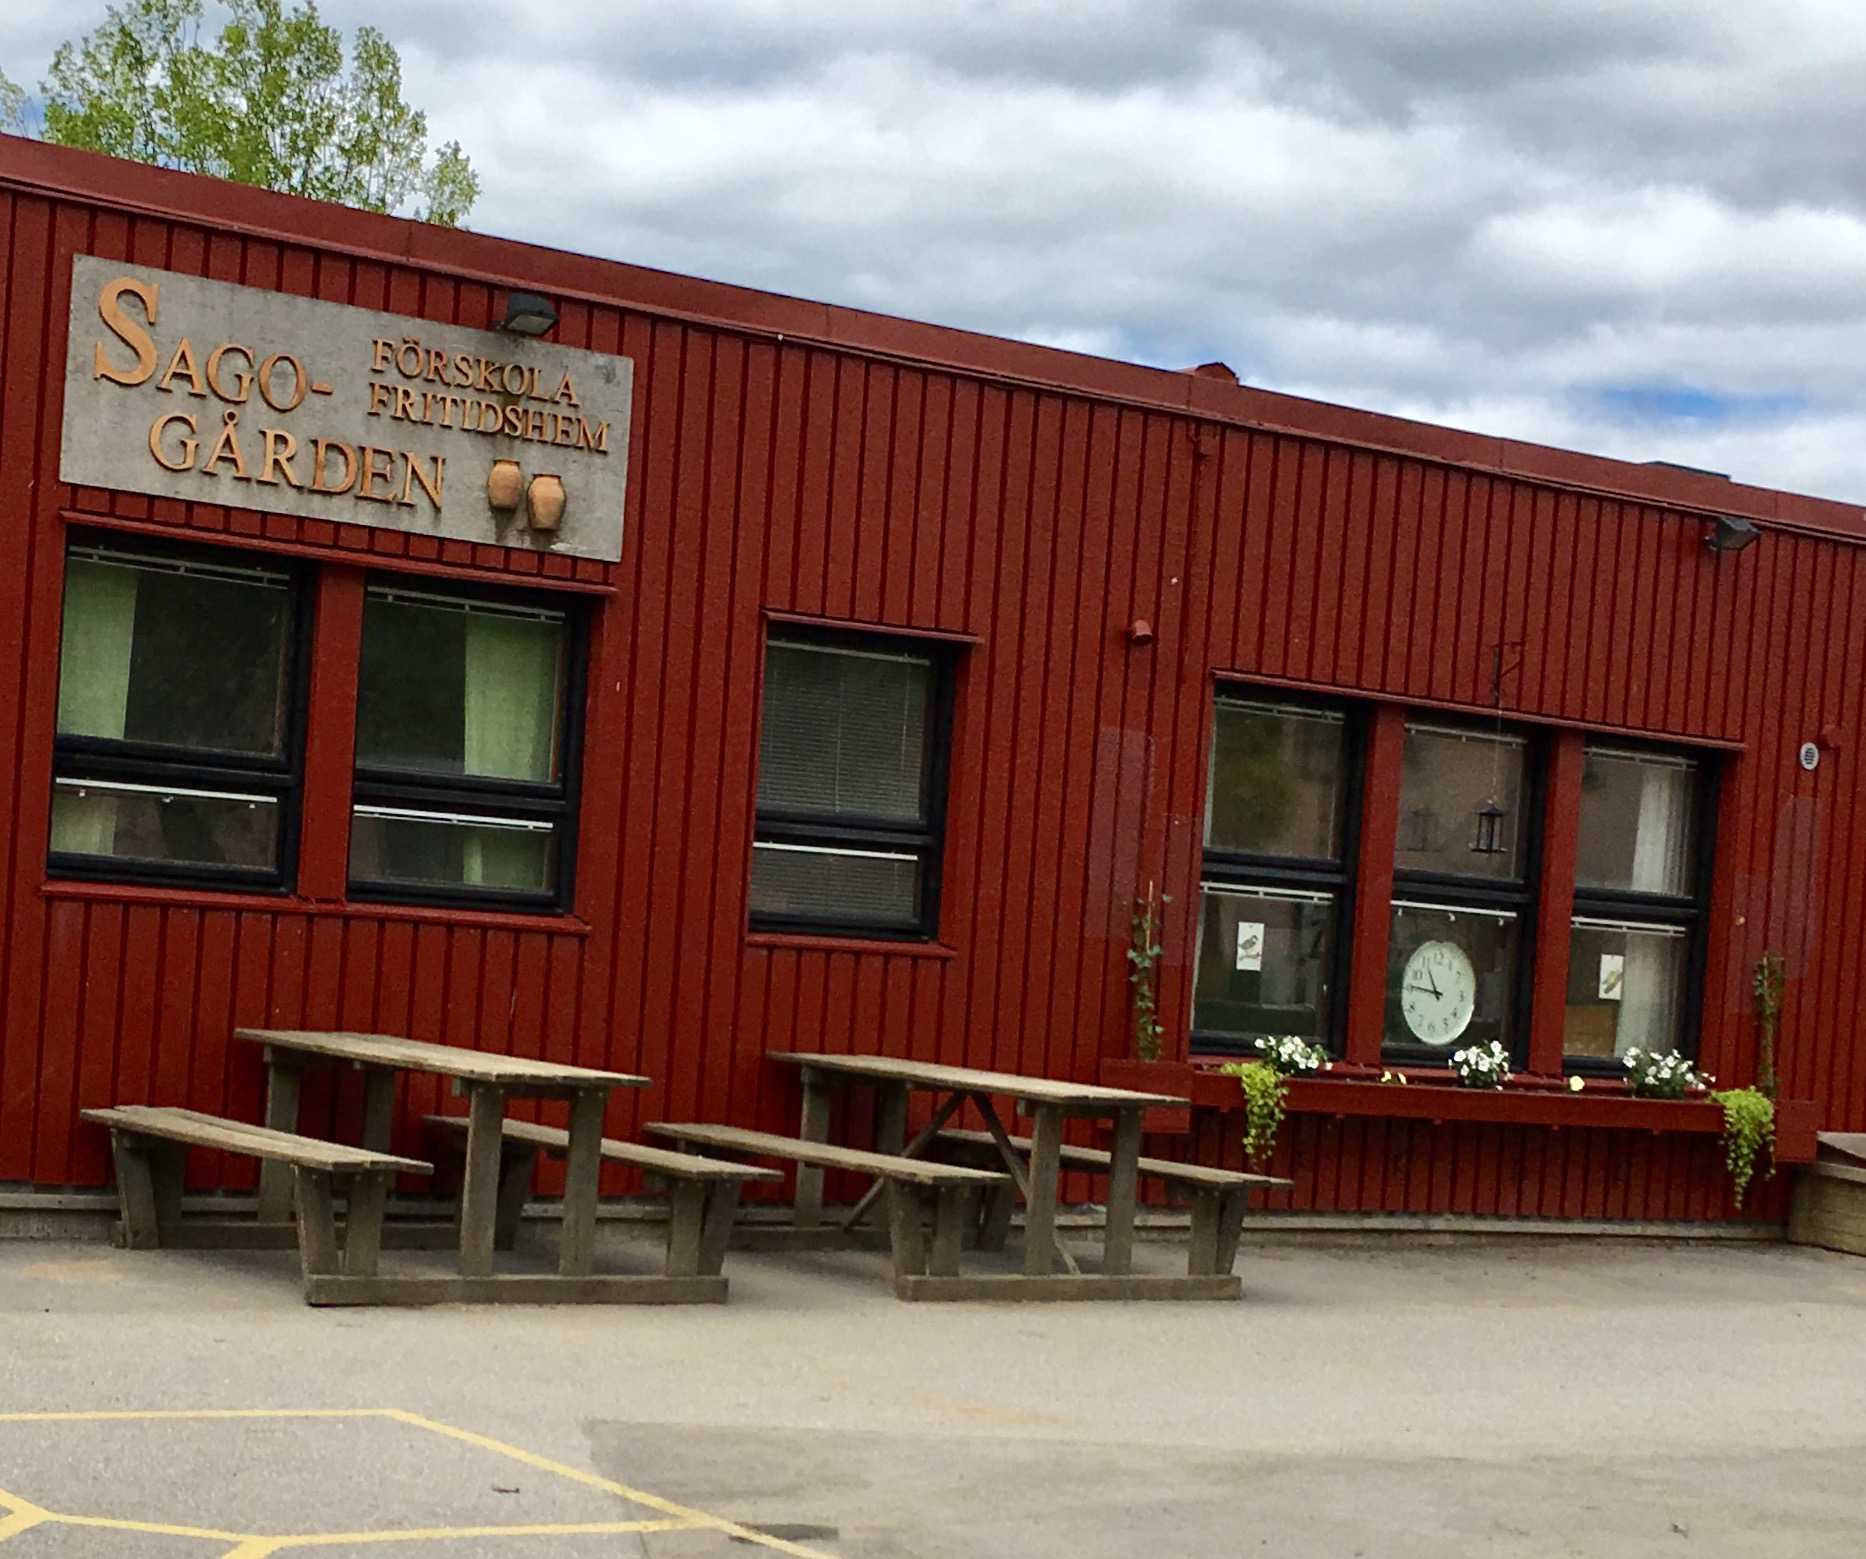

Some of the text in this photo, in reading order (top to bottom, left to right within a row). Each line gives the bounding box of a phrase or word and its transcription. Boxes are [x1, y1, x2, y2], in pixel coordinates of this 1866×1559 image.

[372, 337, 581, 408] FÖRSKOLA
[368, 382, 611, 454] FRITIDSHEM
[149, 410, 446, 511] GÅRDEN
[1412, 969, 1424, 981] 10
[1434, 952, 1444, 966] 12
